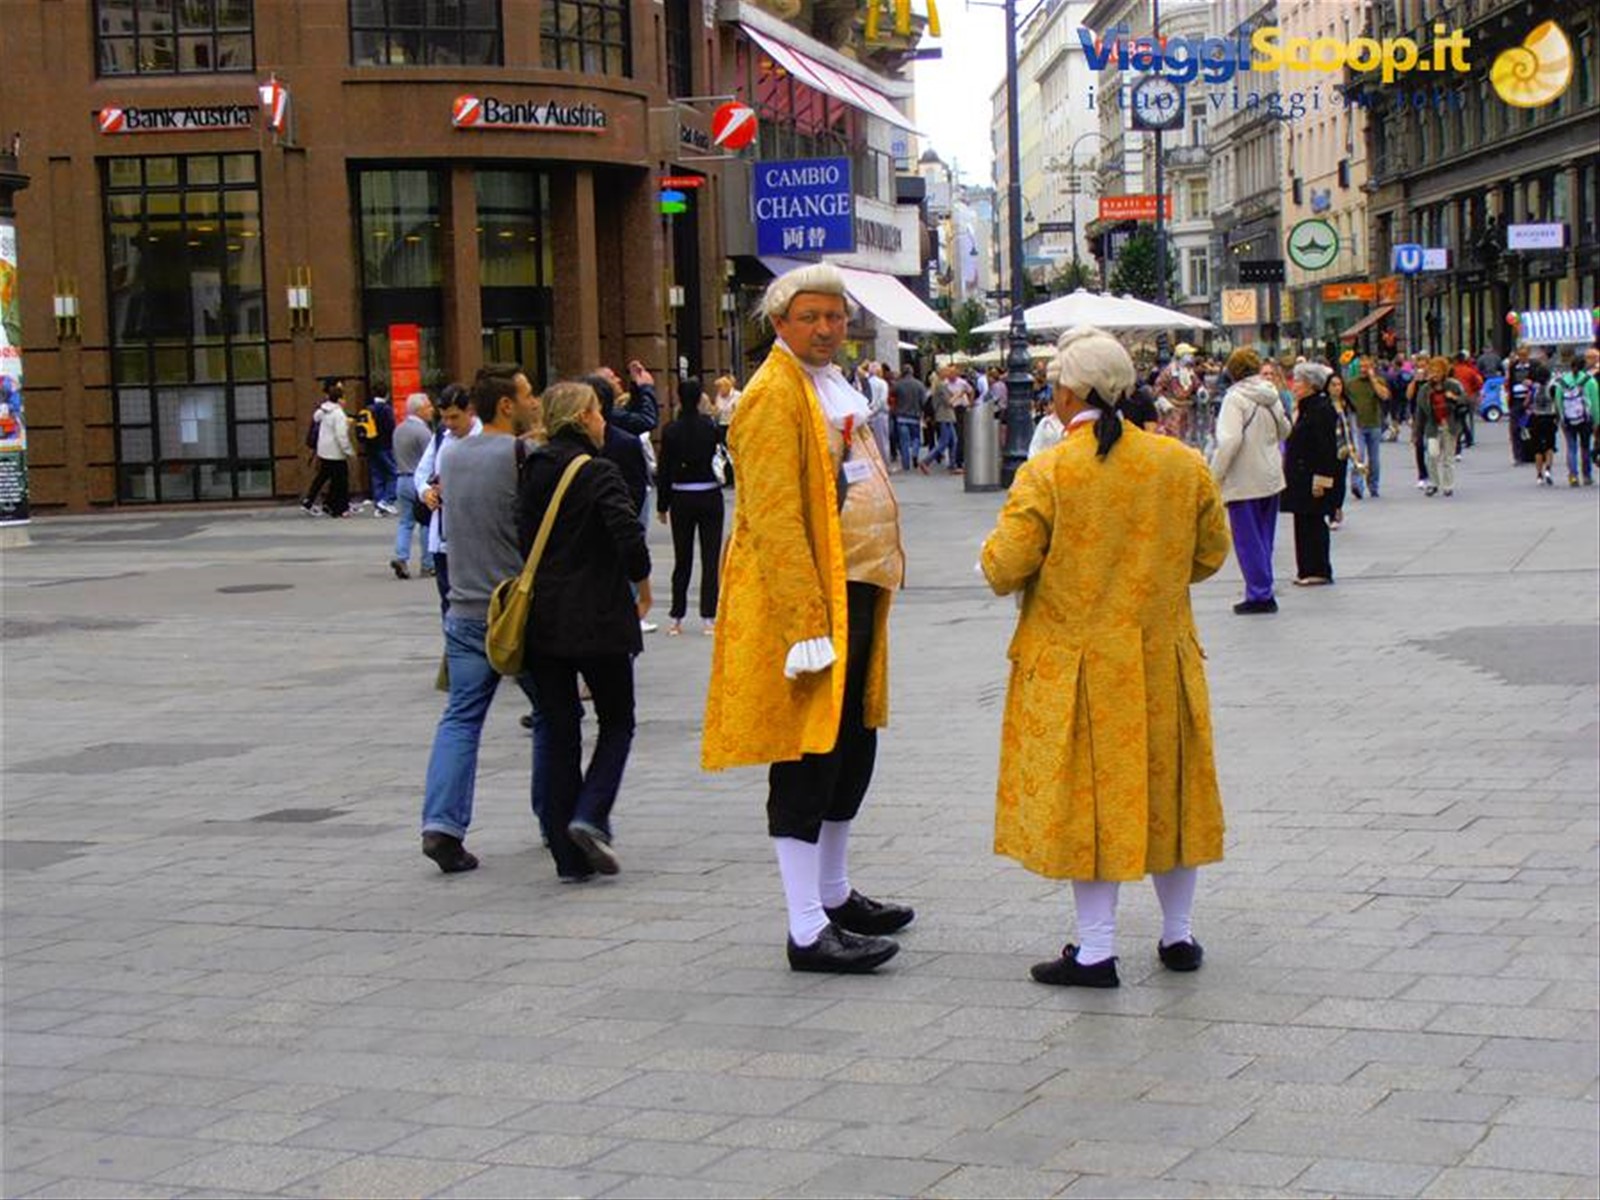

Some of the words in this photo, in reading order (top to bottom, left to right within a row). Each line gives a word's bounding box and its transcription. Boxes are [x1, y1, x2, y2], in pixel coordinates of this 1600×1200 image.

[126, 106, 176, 128] Bank
[182, 103, 251, 126] Austria
[484, 97, 540, 124] Bank
[545, 100, 607, 127] Austria
[766, 165, 840, 188] CAMBIO
[756, 193, 850, 220] CHANGE
[1401, 249, 1420, 271] U
